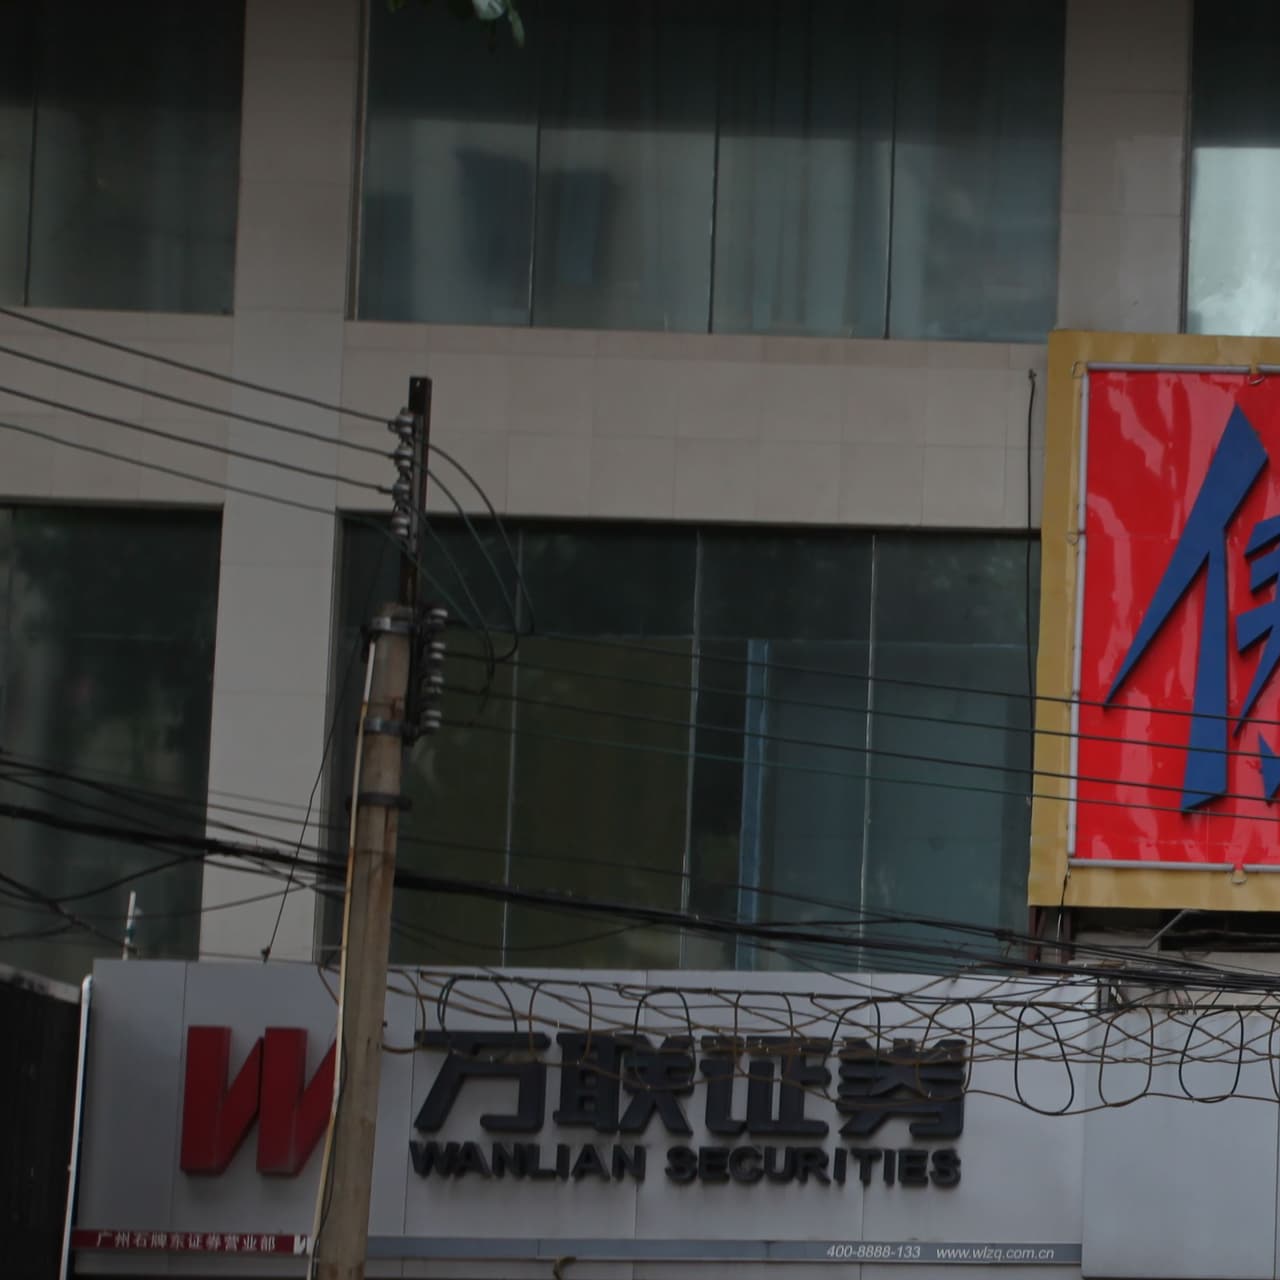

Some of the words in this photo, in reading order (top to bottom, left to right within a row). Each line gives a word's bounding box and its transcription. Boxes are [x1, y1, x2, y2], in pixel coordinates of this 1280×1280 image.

[414, 1030, 966, 1138] 万联证券
[410, 1141, 646, 1181] WANLIAN
[666, 1145, 961, 1187] SECURITIES
[826, 1244, 921, 1259] 400-8888-133
[936, 1246, 1055, 1262] www.wlzq.com.cn
